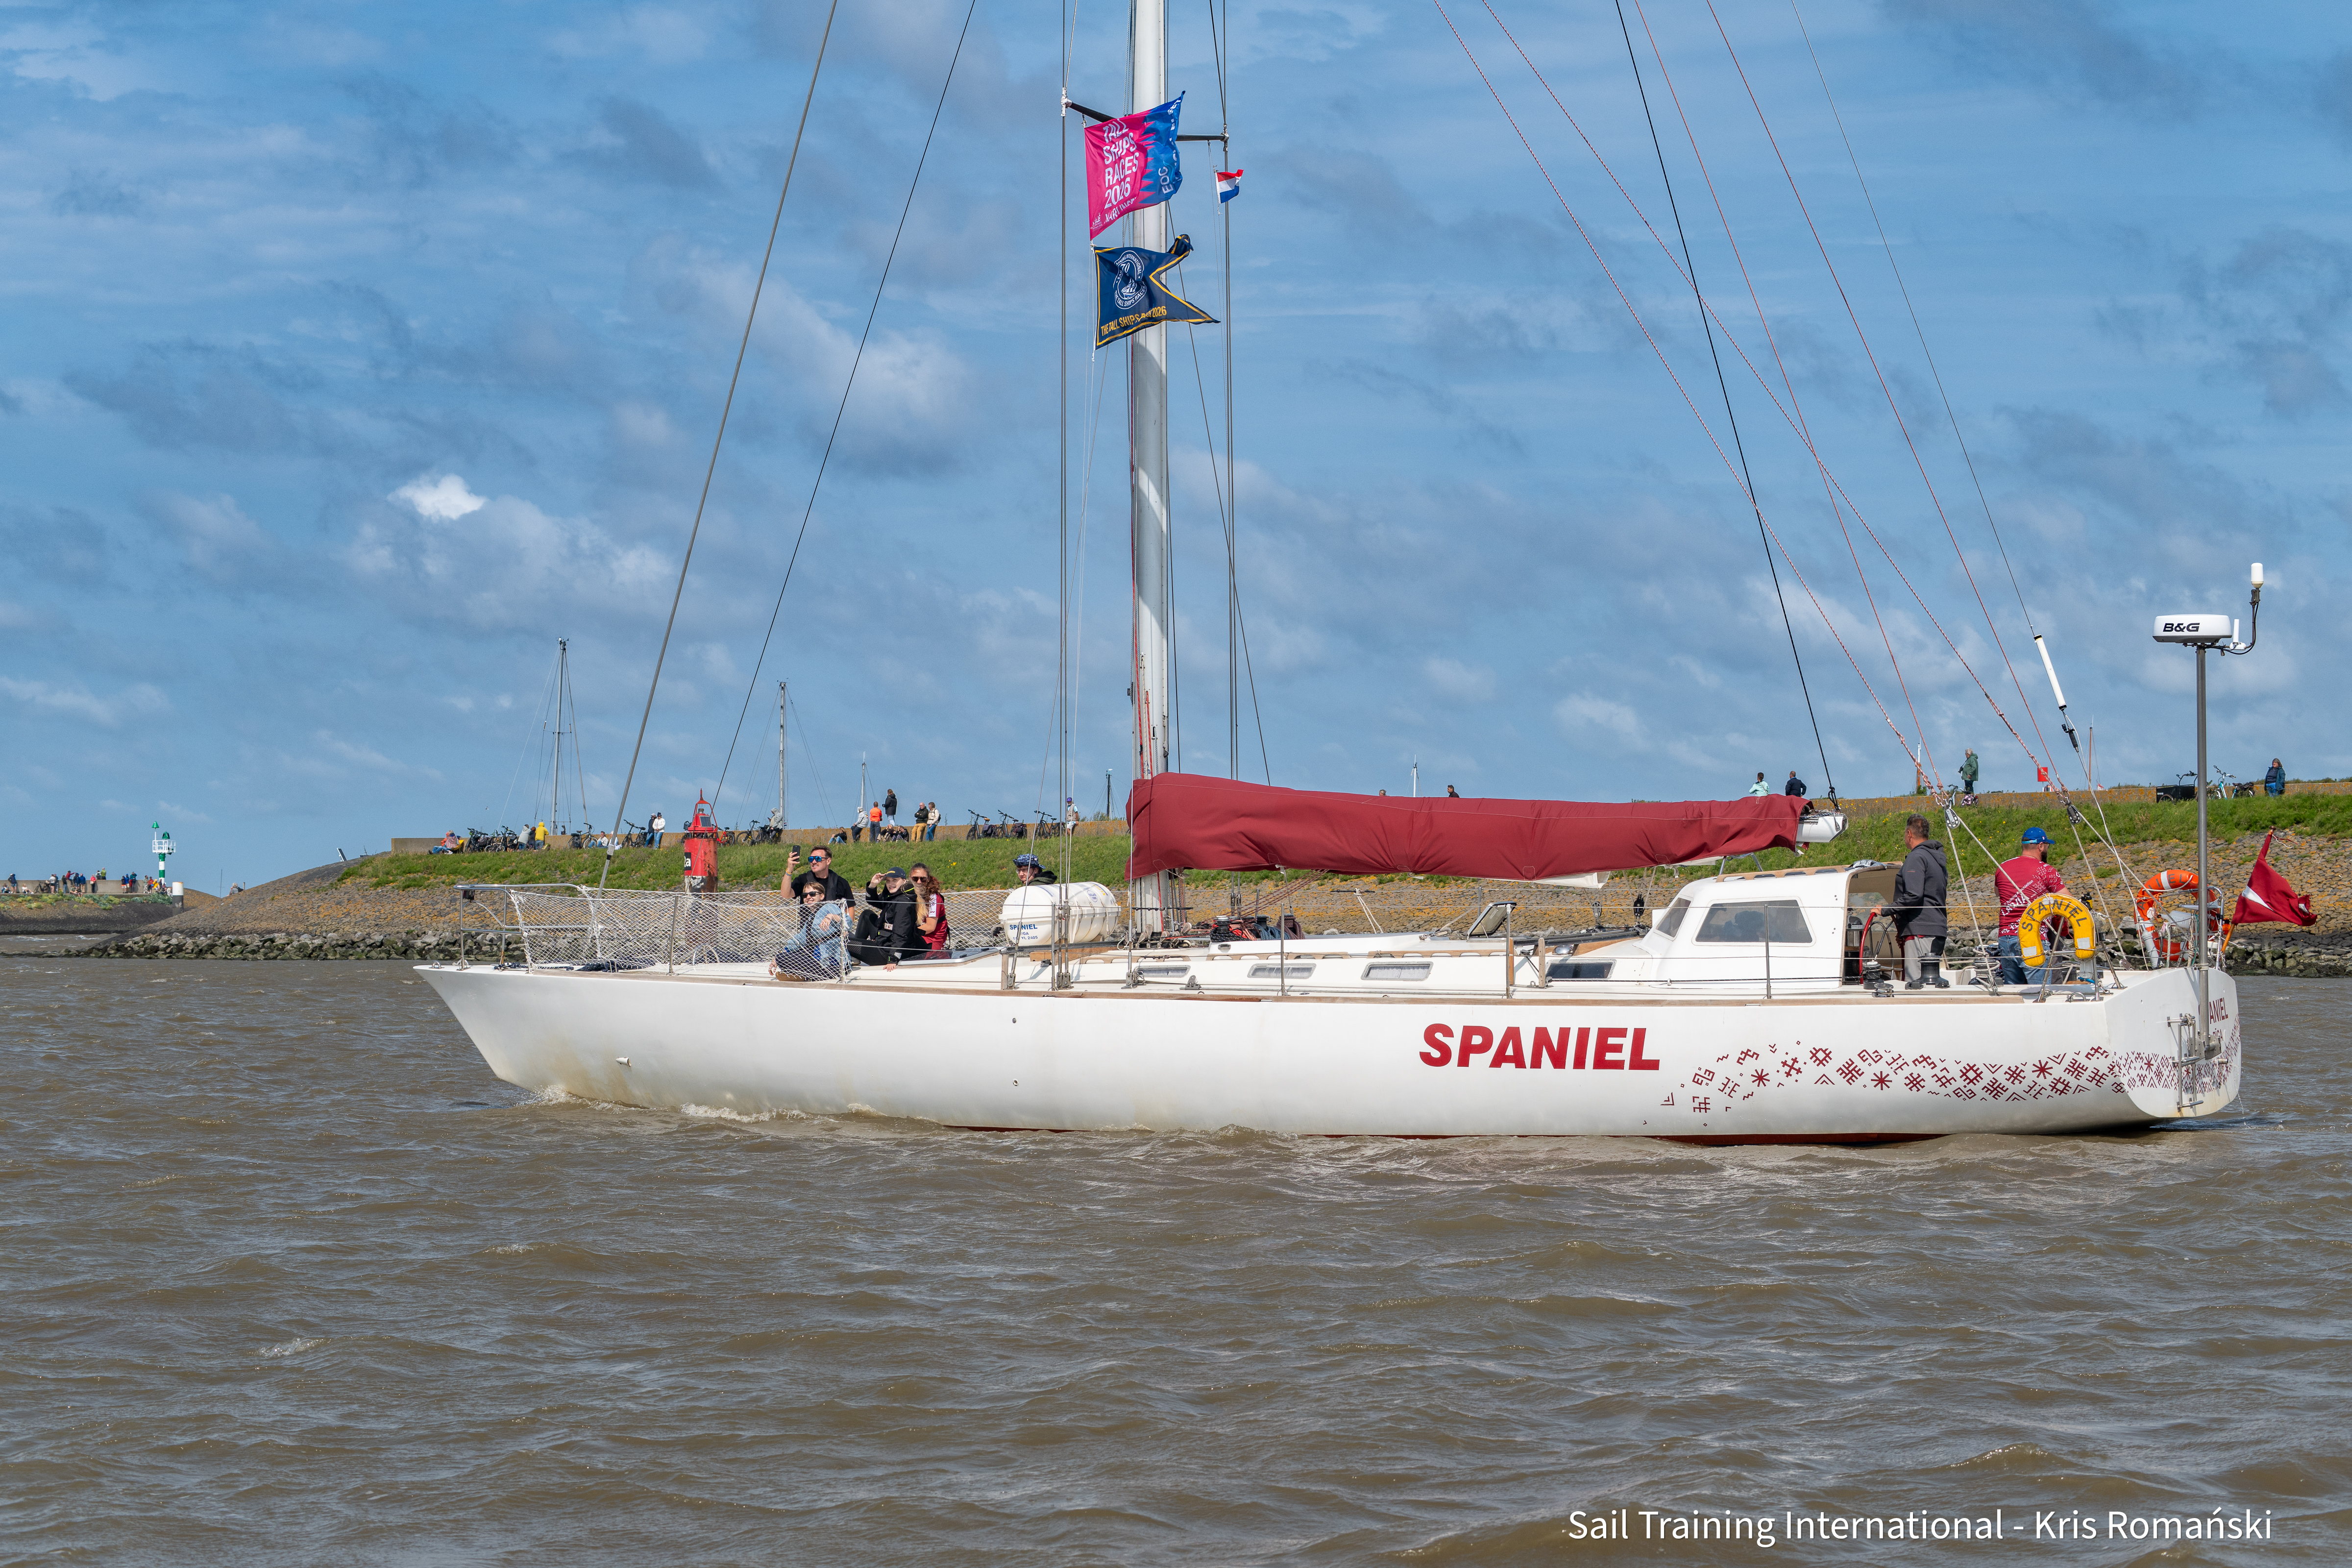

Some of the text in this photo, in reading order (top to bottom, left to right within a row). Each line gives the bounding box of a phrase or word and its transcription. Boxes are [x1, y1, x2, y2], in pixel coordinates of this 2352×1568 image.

[1102, 119, 1129, 144] TALL
[1103, 133, 1137, 165] SHIPS
[1105, 152, 1139, 188] RACES
[1158, 167, 1174, 194] EOC
[1104, 177, 1130, 209] 2026
[1120, 262, 1130, 273] 70
[1126, 253, 1142, 275] INTERNATIONAL
[1124, 297, 1135, 307] SHIPS
[1134, 285, 1146, 301] RACES
[1108, 319, 1120, 332] TALL
[1119, 314, 1140, 327] SHIPS
[1152, 306, 1167, 318] 2026
[2163, 623, 2200, 632] B&G
[2022, 898, 2087, 932] SPANIEL
[1419, 1023, 1660, 1071] SPANIEL
